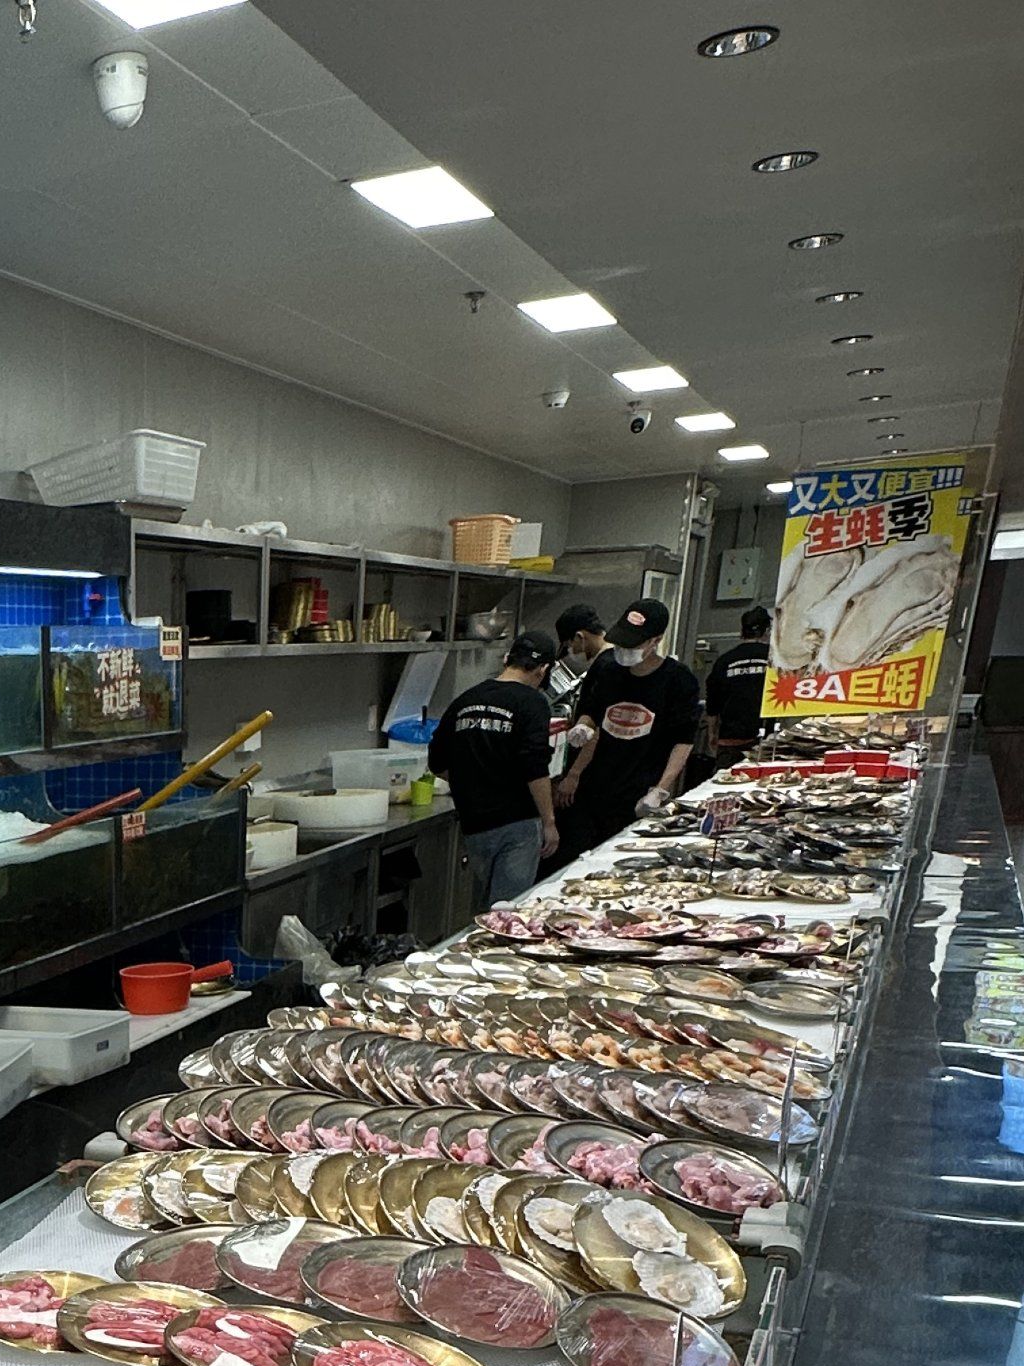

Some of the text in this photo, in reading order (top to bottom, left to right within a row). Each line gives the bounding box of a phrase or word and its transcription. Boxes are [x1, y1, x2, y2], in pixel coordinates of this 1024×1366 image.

[790, 467, 964, 515] 又大又便宜!!!
[807, 496, 931, 555] 生蚝季
[97, 647, 134, 682] 不新鲜
[793, 661, 919, 706] 8A巨蚝
[102, 679, 141, 715] 就退菜
